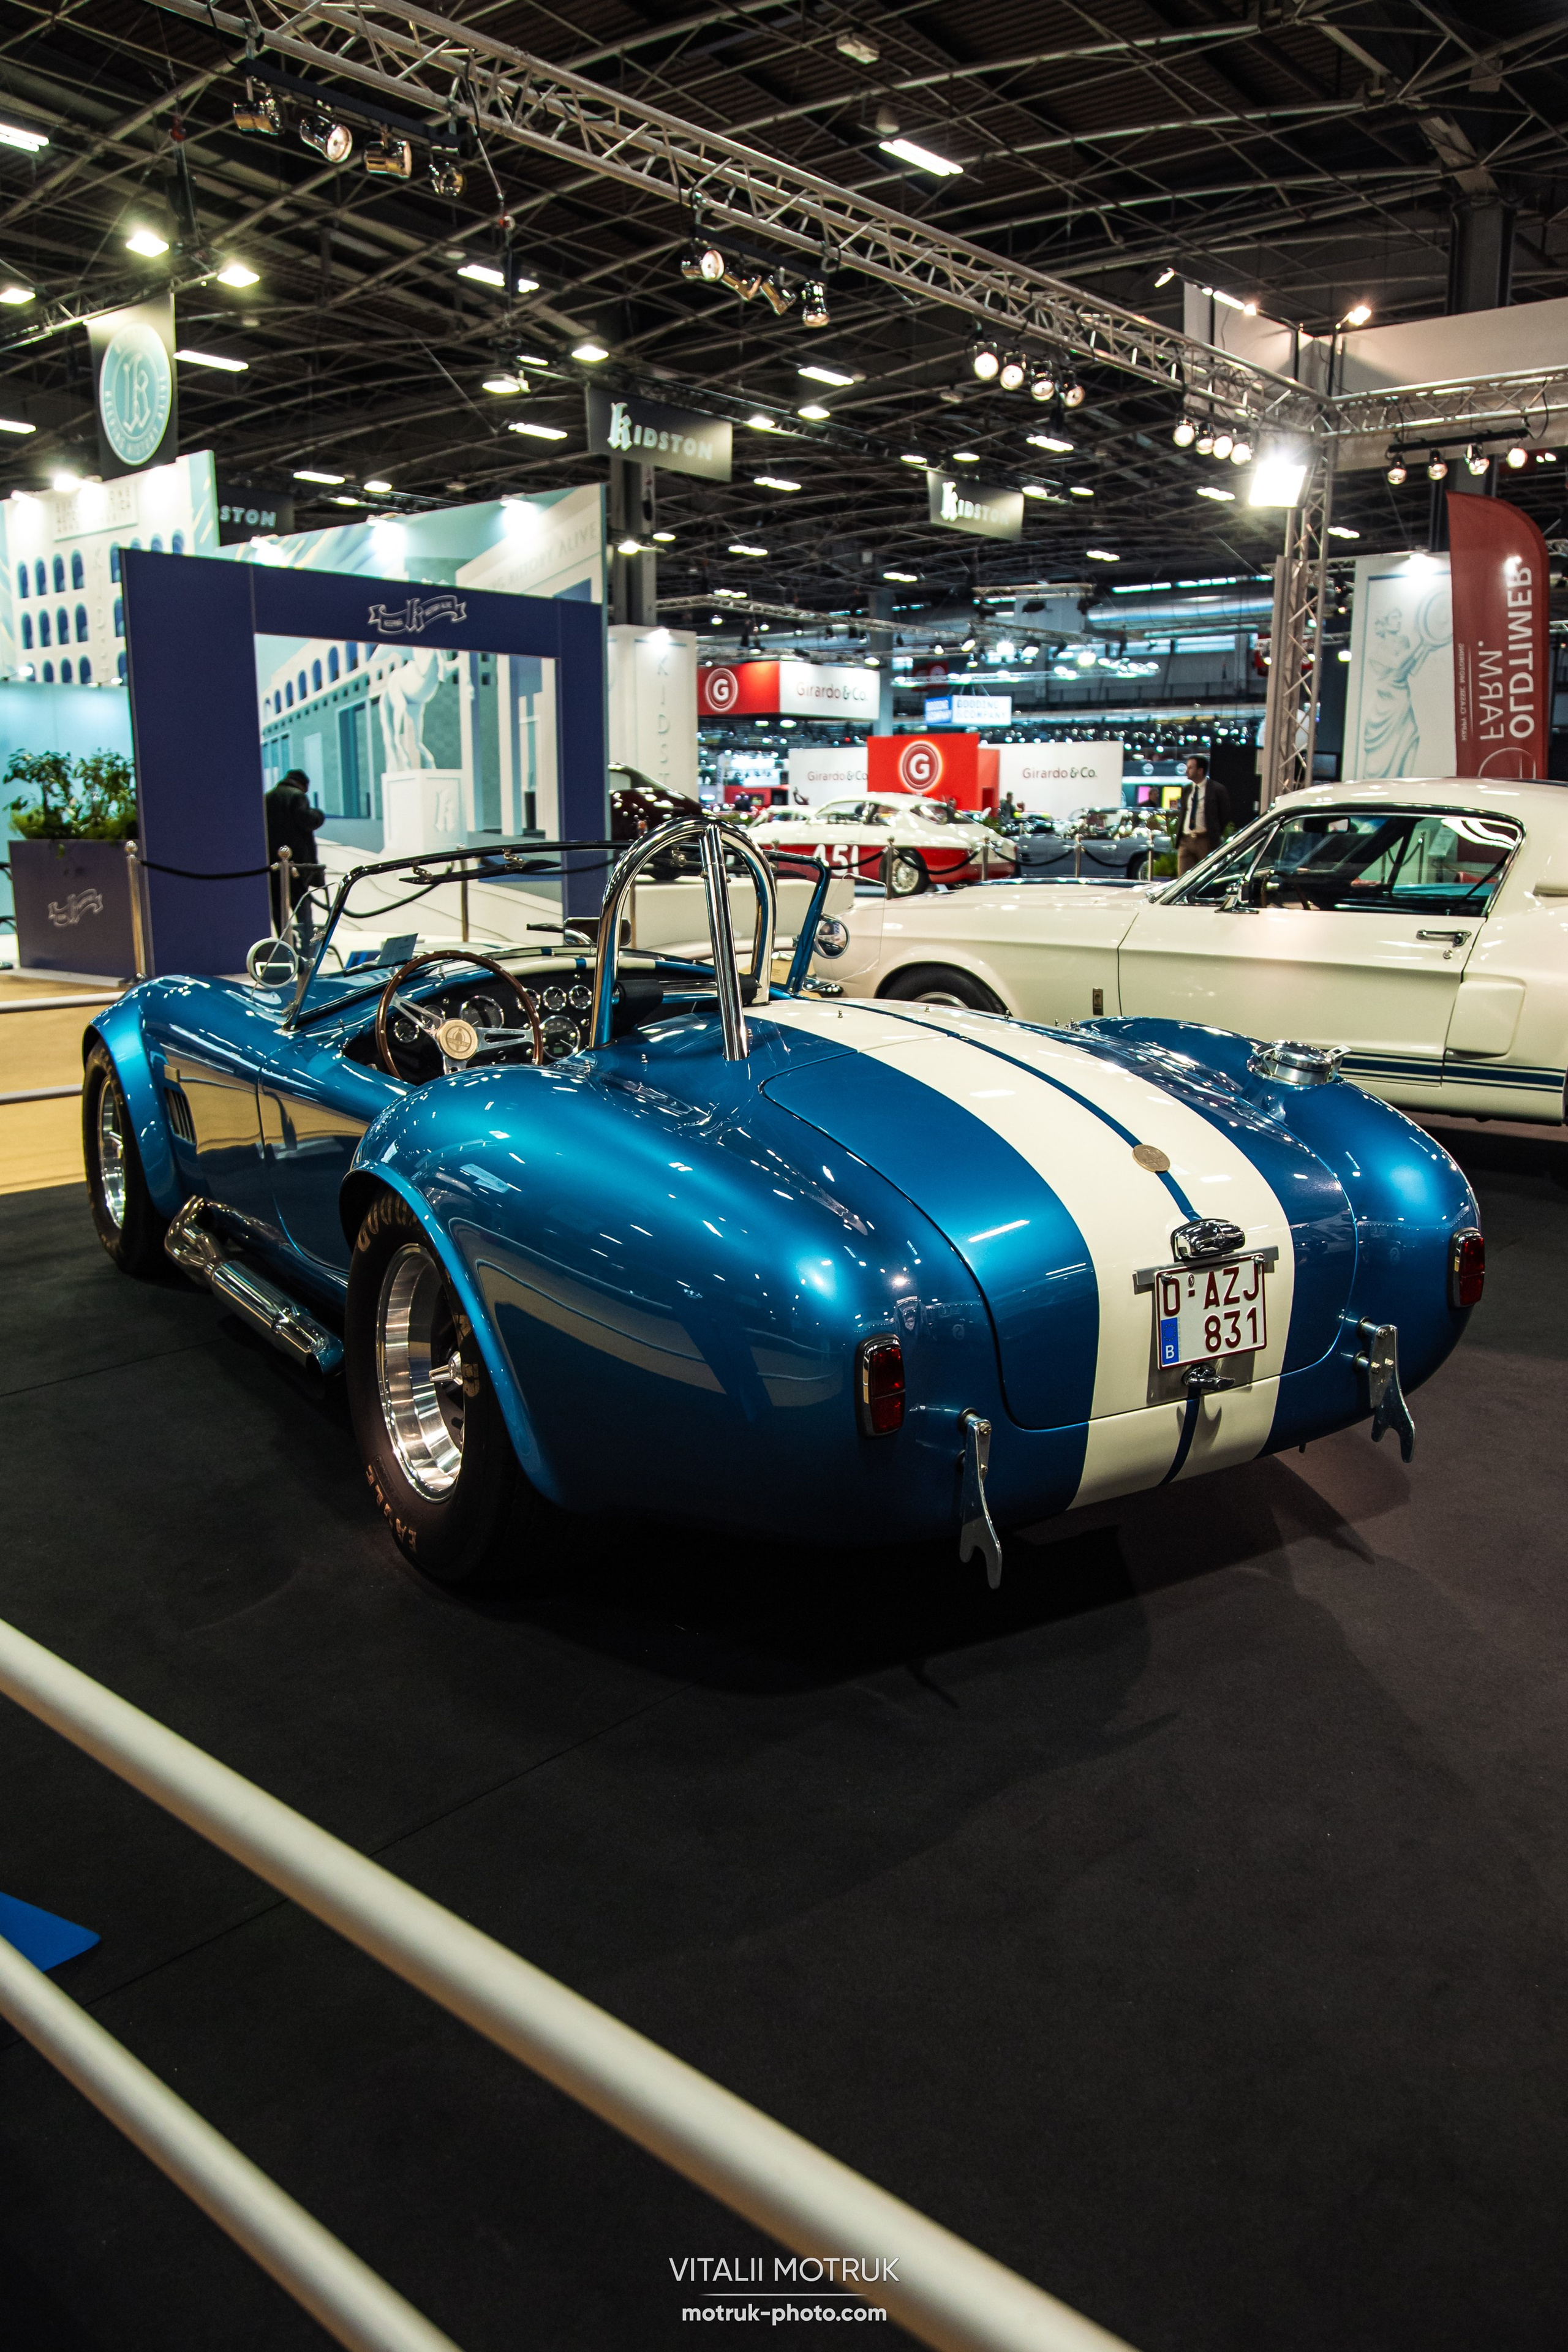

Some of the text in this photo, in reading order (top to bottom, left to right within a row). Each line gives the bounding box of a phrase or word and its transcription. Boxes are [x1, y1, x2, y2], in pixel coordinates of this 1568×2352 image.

[607, 402, 713, 460] KIDSTON
[940, 481, 1009, 526] KIDSTON
[220, 505, 276, 528] STON
[713, 679, 729, 701] G
[796, 682, 841, 699] Girardo
[807, 771, 845, 781] Girardo
[847, 770, 854, 781] &
[910, 753, 930, 780] G
[1023, 767, 1068, 779] Girardo
[1070, 767, 1079, 778] &
[1204, 1306, 1257, 1353] 831
[1165, 1344, 1175, 1360] B
